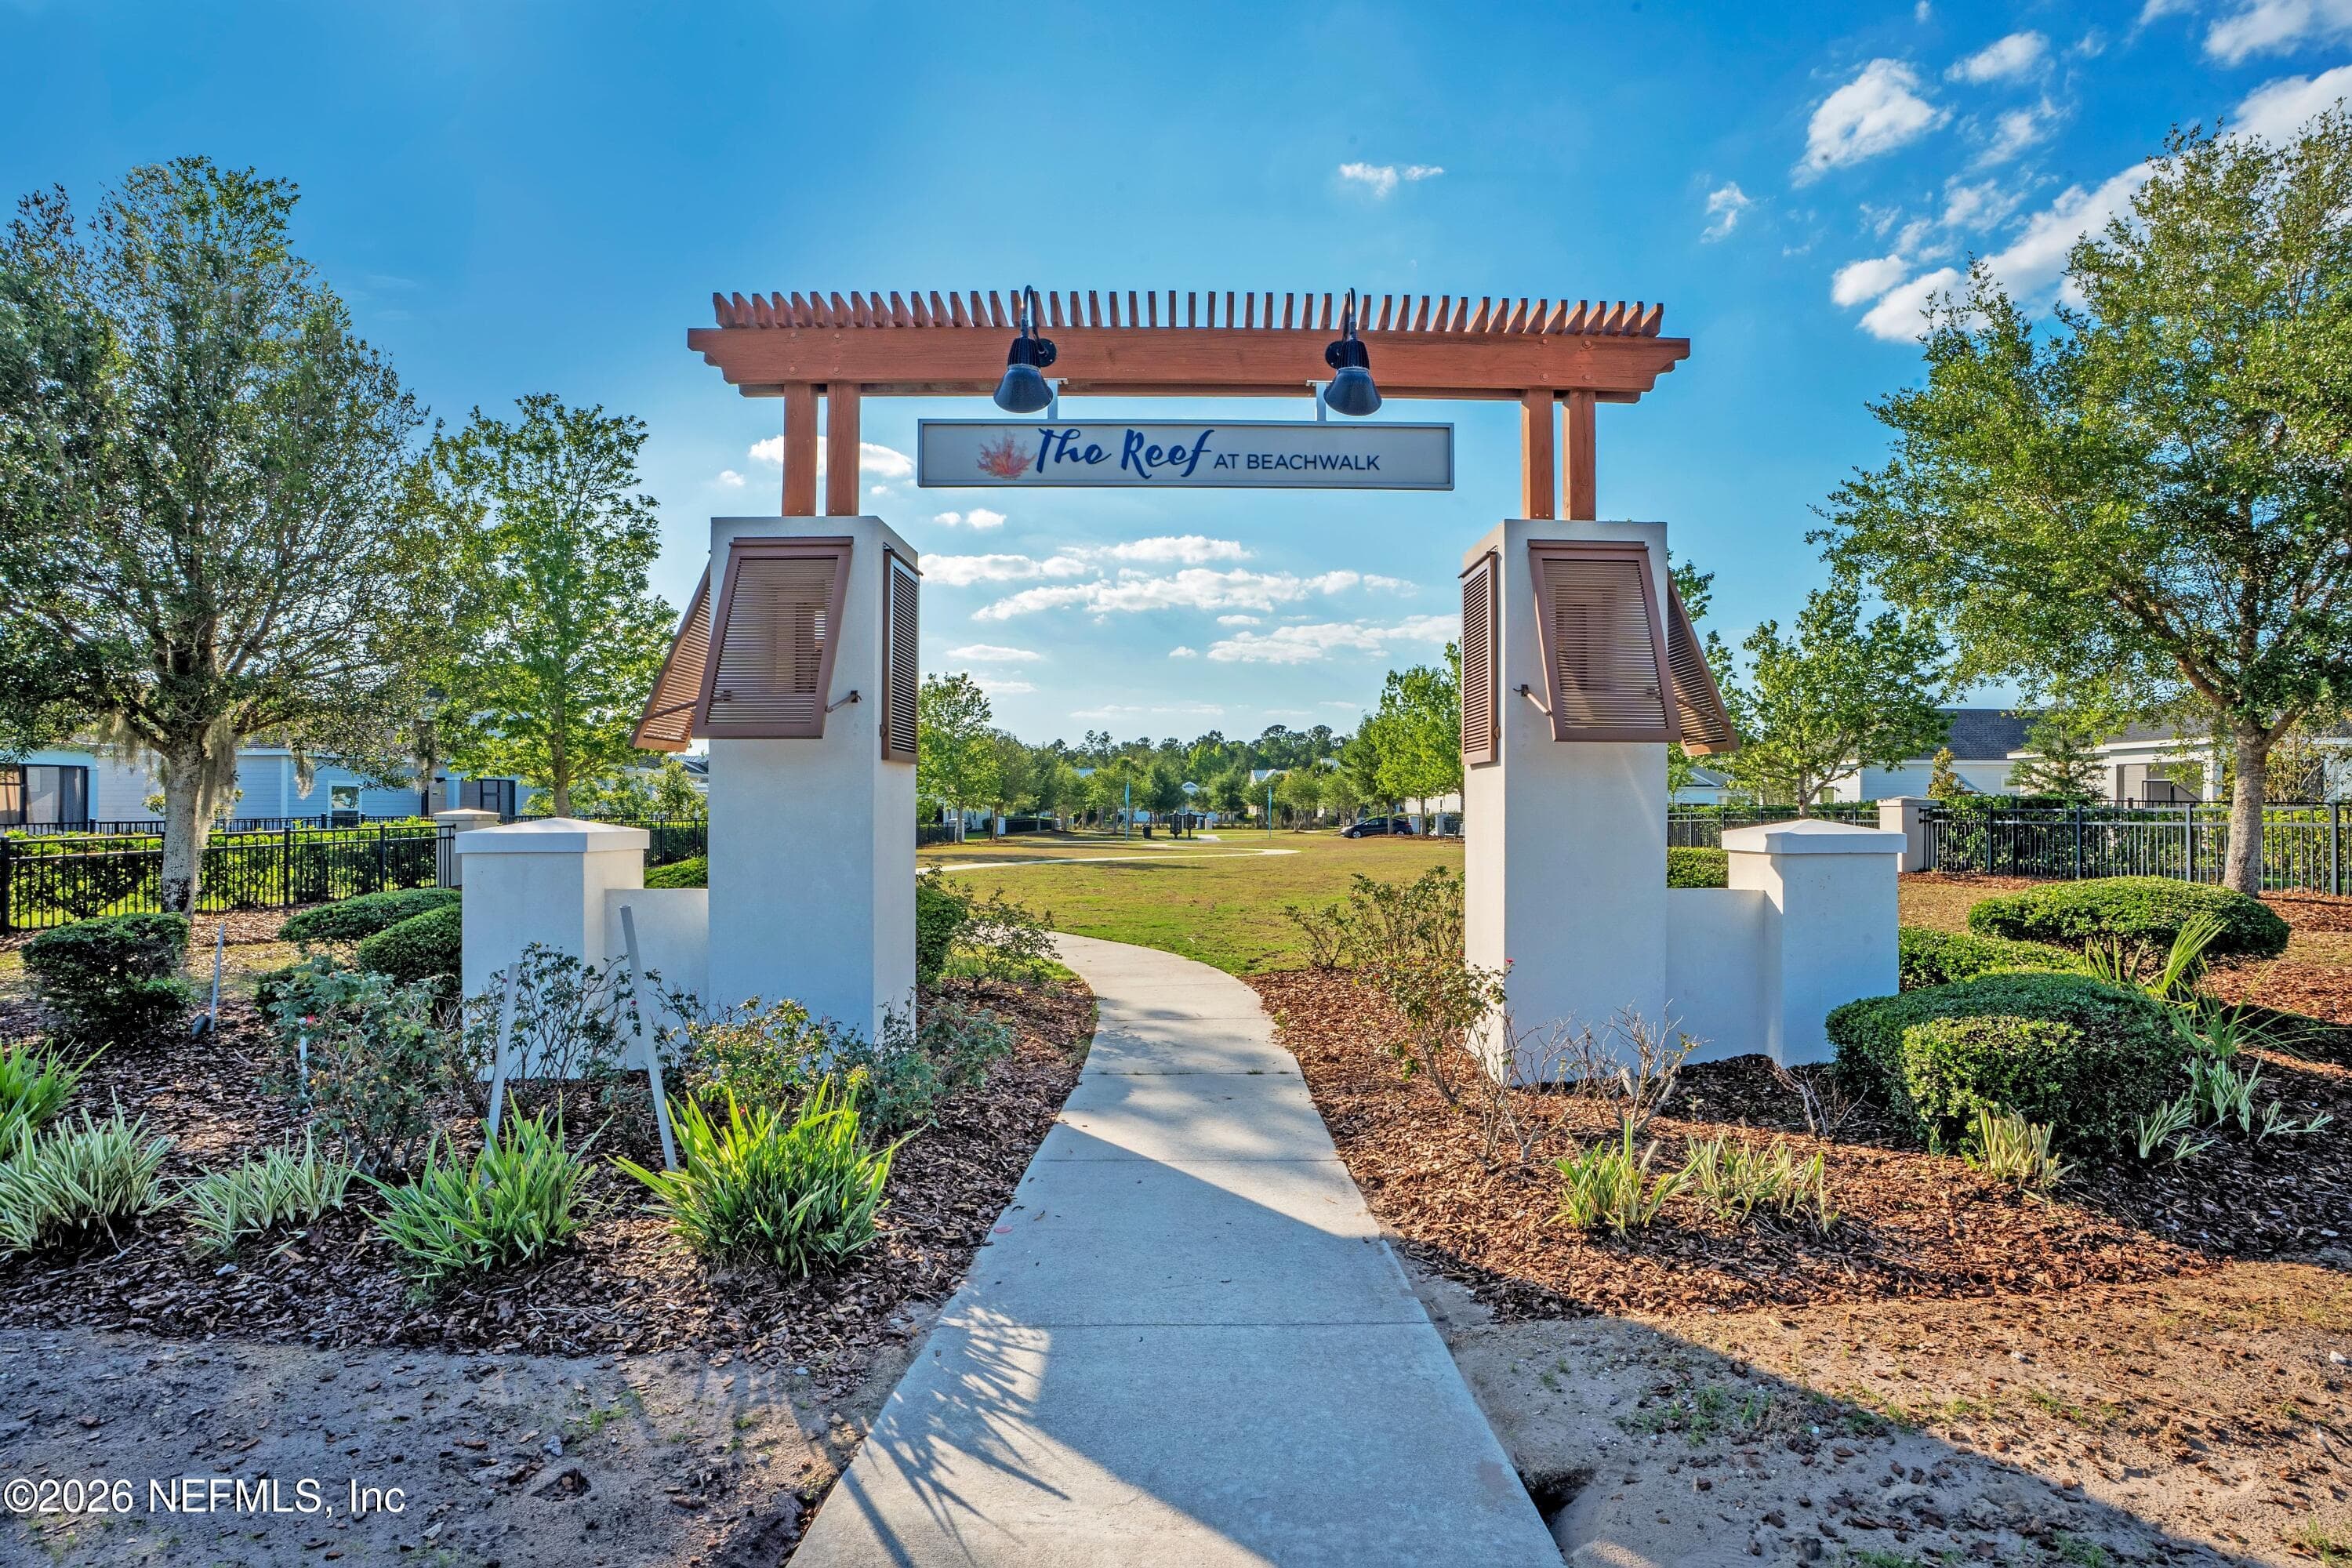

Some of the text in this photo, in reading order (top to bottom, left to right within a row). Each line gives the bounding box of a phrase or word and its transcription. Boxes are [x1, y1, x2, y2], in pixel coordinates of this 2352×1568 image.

[1036, 428, 1381, 480] The Reef AT BEACHWALK
